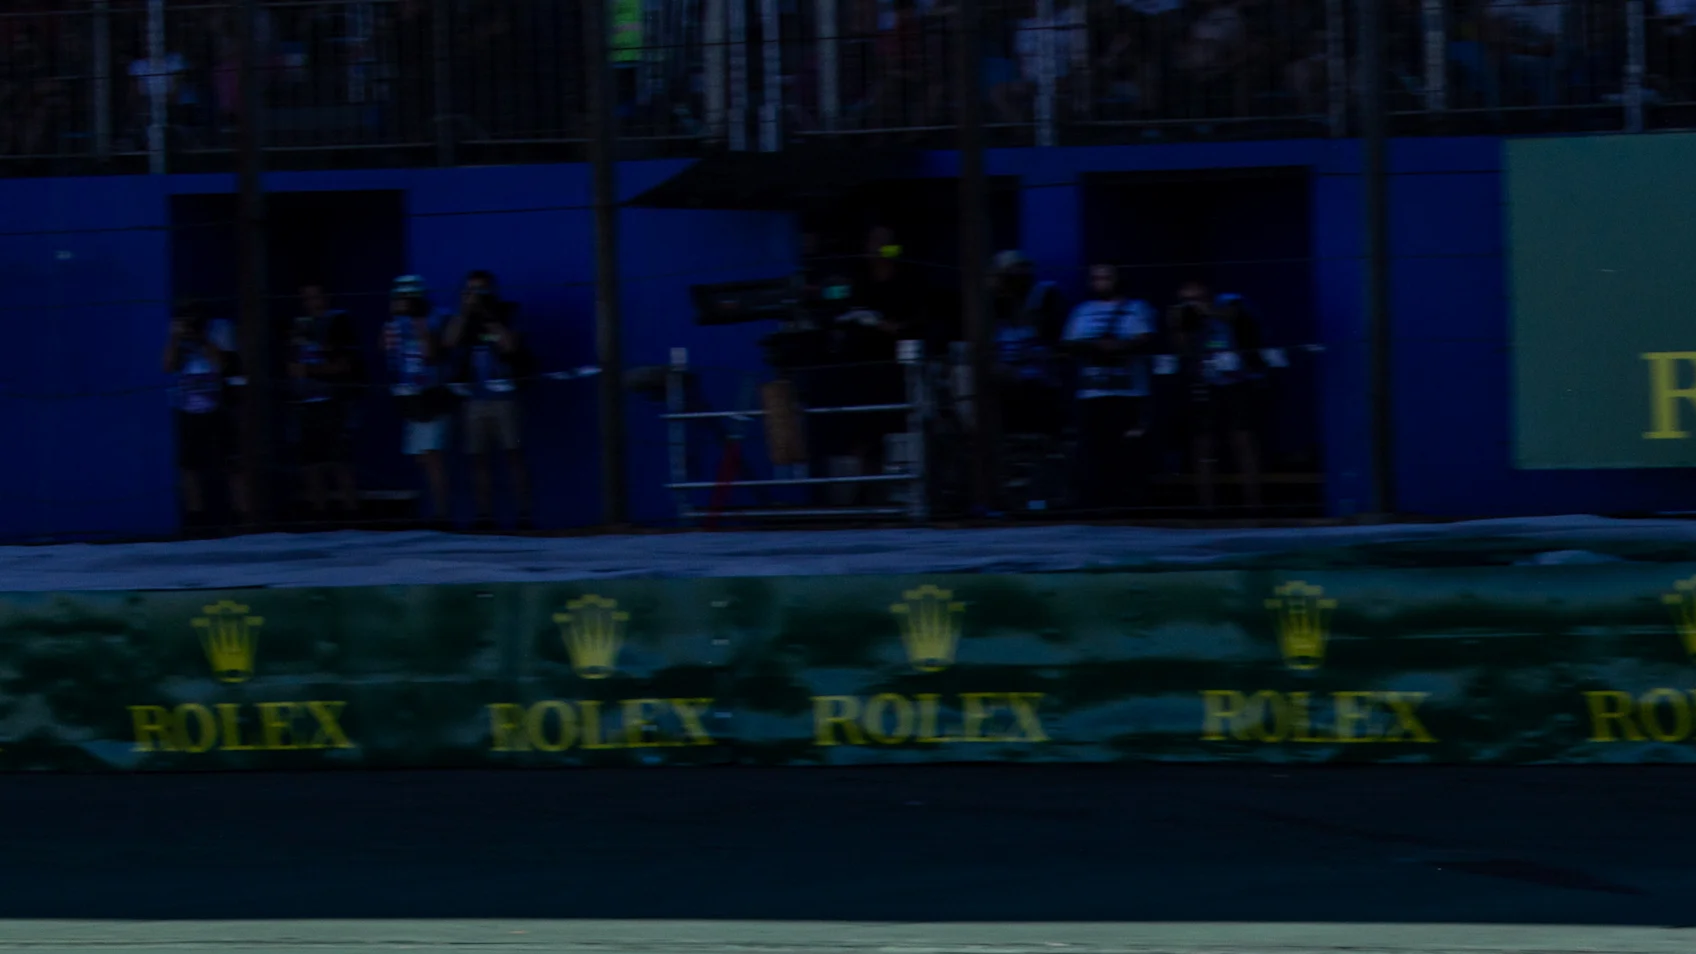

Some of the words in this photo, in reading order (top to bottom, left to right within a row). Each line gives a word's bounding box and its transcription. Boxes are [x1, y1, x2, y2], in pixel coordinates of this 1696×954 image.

[130, 701, 348, 752] ROLEX
[493, 698, 713, 750] ROLEX
[814, 692, 1042, 745] ROLEX
[1204, 690, 1434, 743] ROLEX
